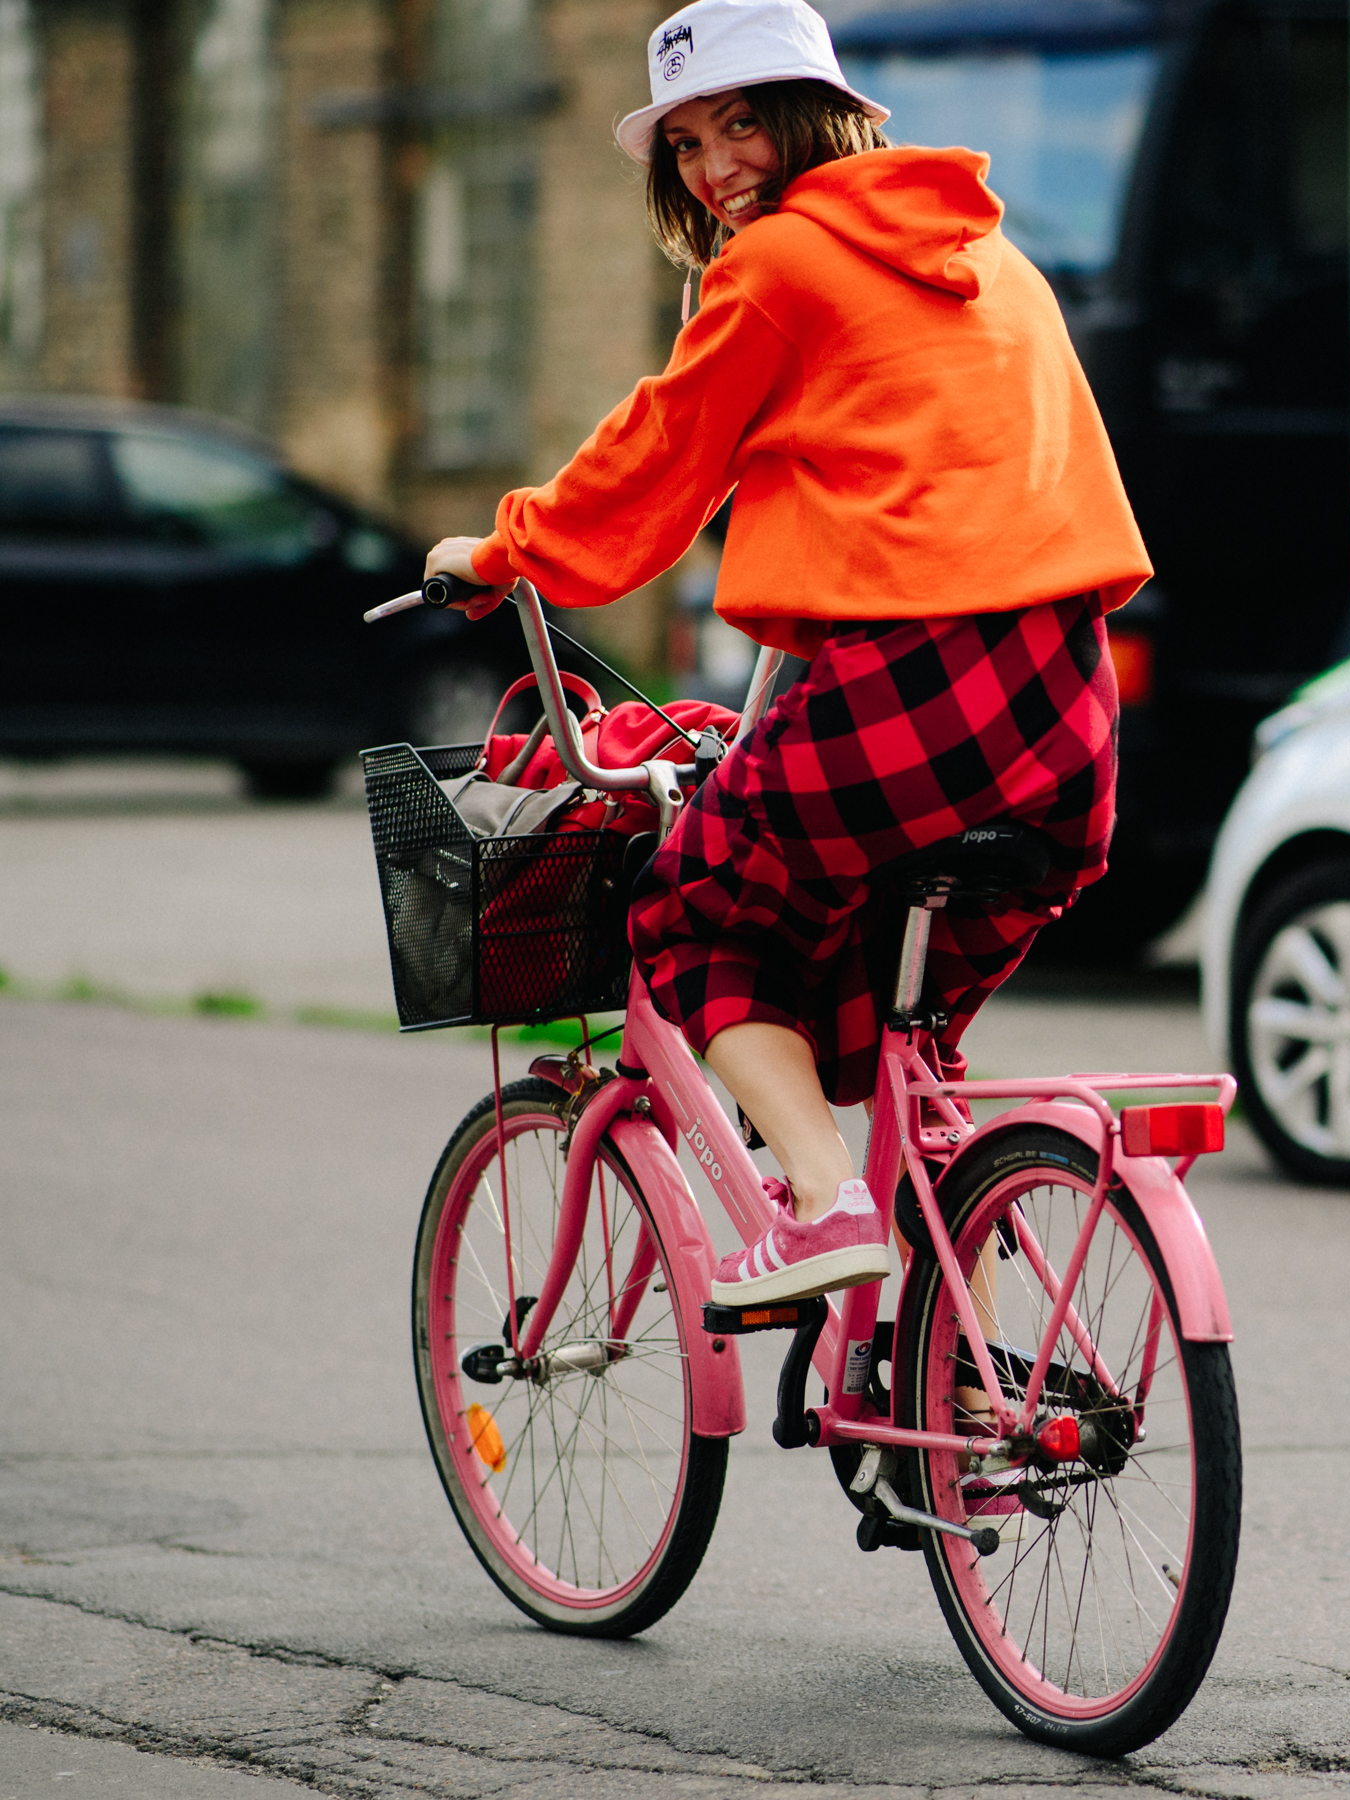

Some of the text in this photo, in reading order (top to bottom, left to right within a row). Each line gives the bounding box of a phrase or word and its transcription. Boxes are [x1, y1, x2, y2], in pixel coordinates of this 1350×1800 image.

[962, 829, 997, 843] jopo
[685, 1116, 722, 1181] jopo
[993, 1150, 1037, 1168] SCHWALBE
[1014, 1704, 1042, 1725] 47-507
